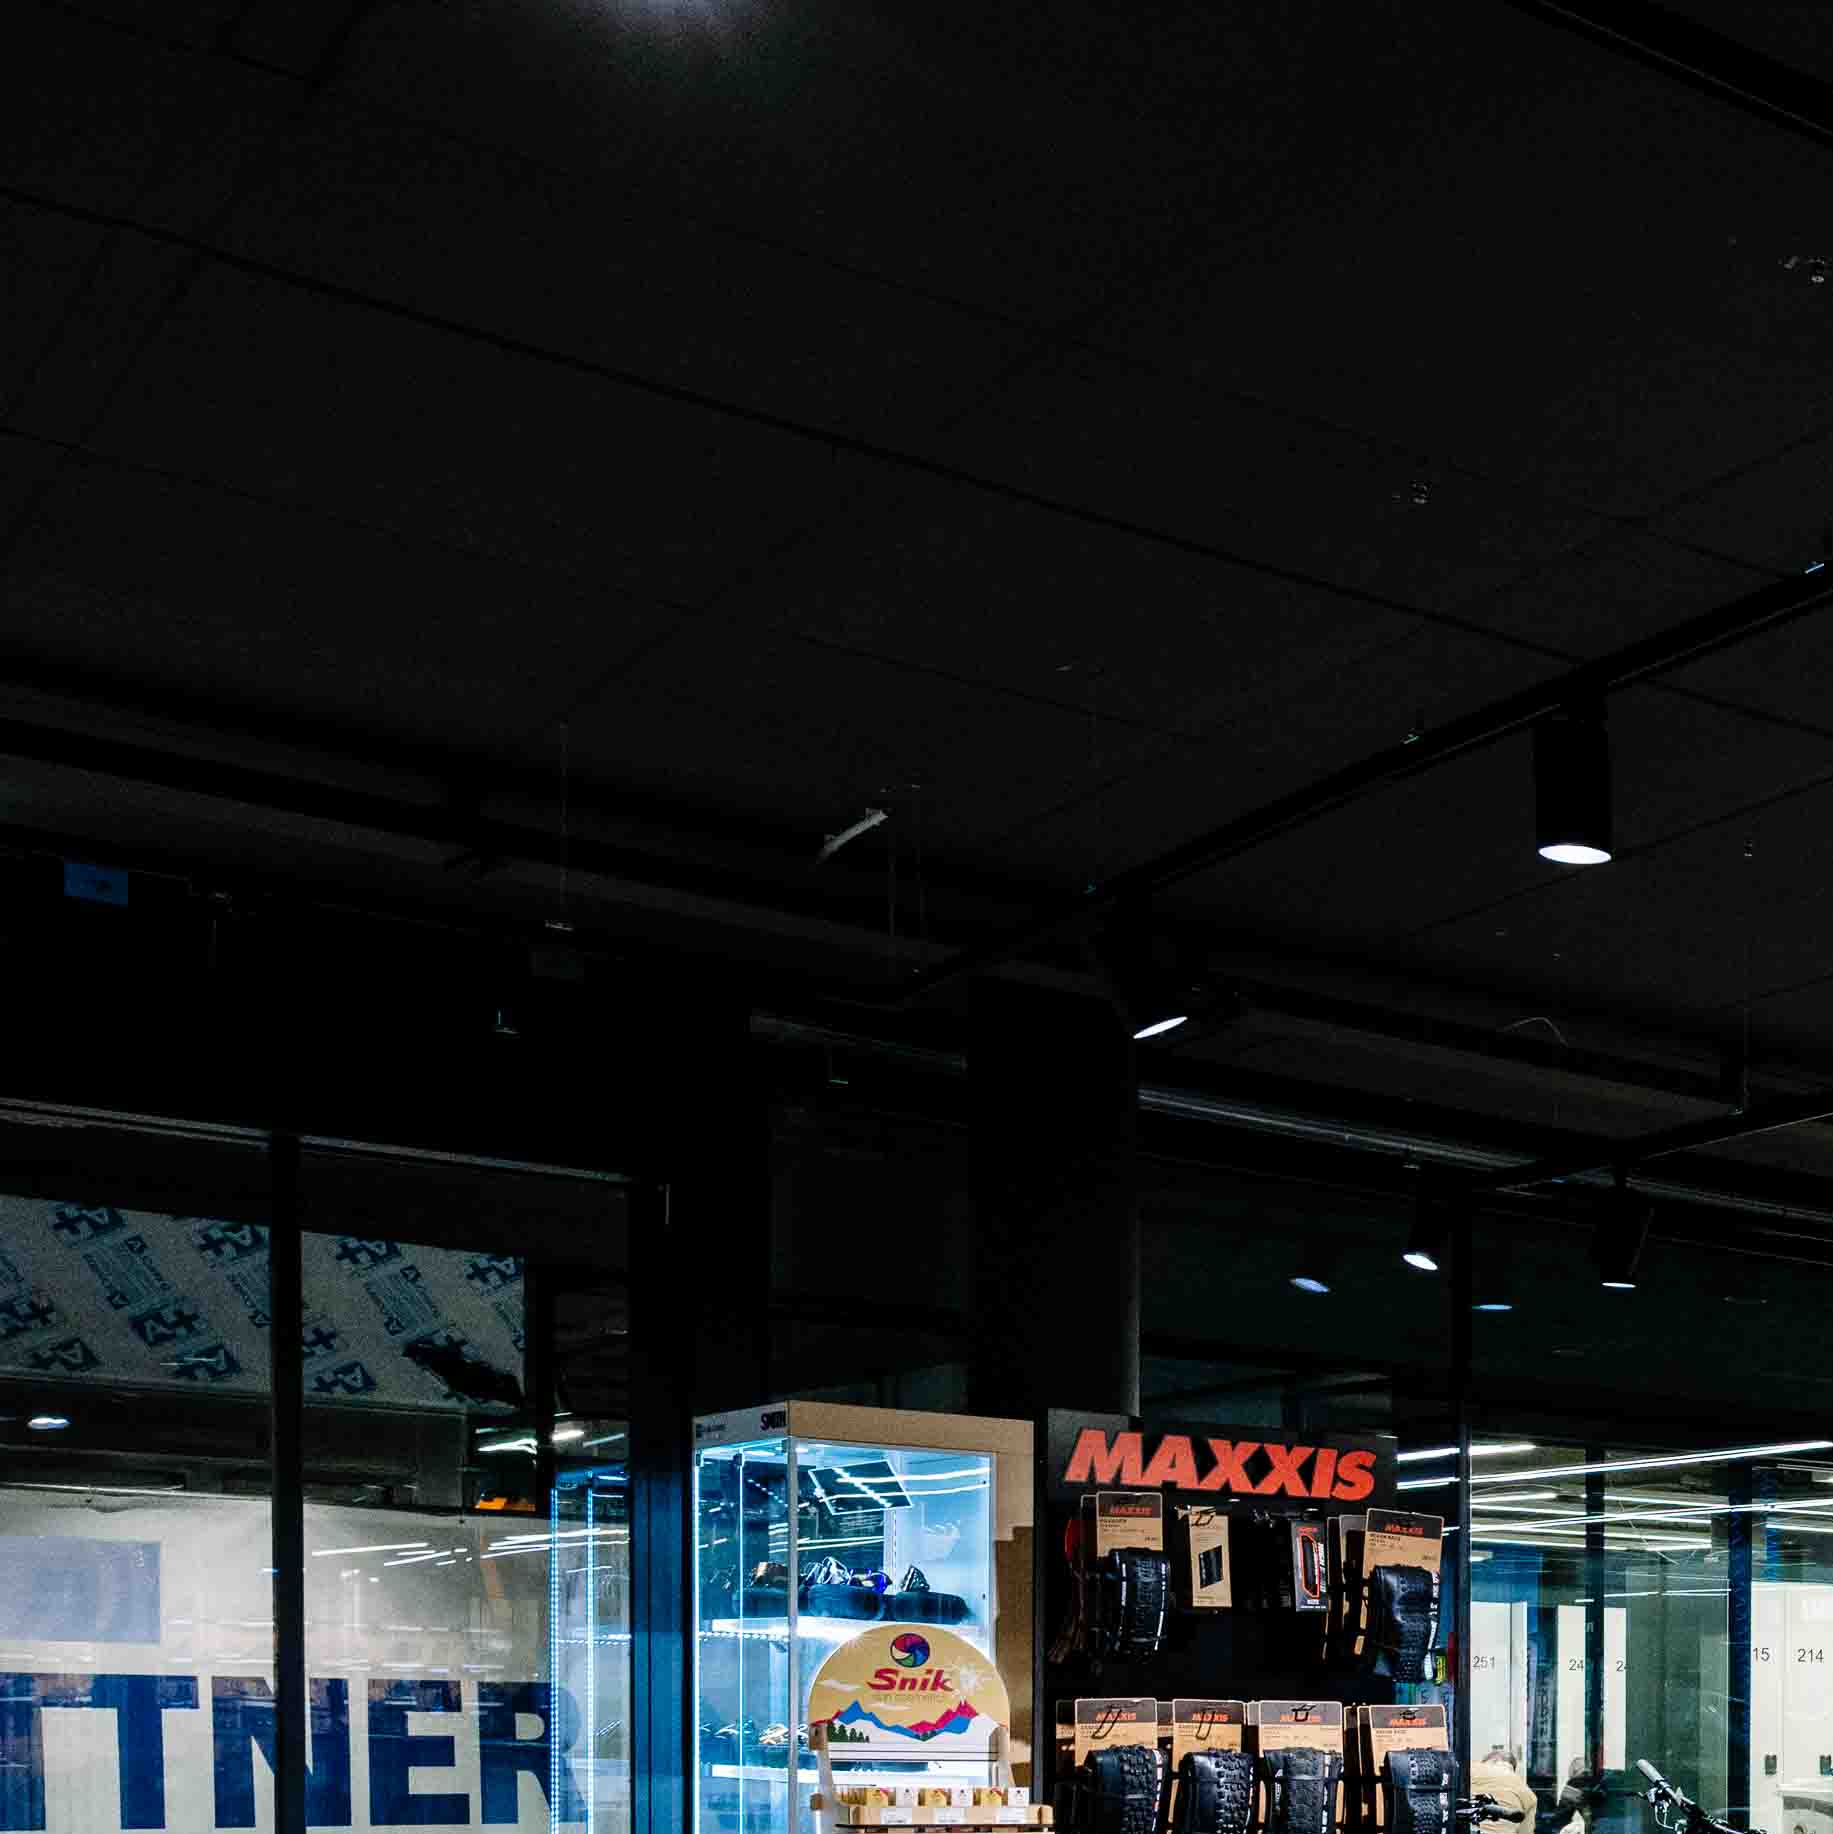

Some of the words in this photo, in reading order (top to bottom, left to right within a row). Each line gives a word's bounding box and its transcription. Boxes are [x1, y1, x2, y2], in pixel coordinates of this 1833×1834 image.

[1065, 1429, 1376, 1501] MAXXIS
[1753, 1648, 1770, 1661] 15
[1797, 1649, 1824, 1663] 214
[1473, 1656, 1496, 1669] 251
[1569, 1658, 1585, 1671] 24
[866, 1667, 953, 1692] Snik
